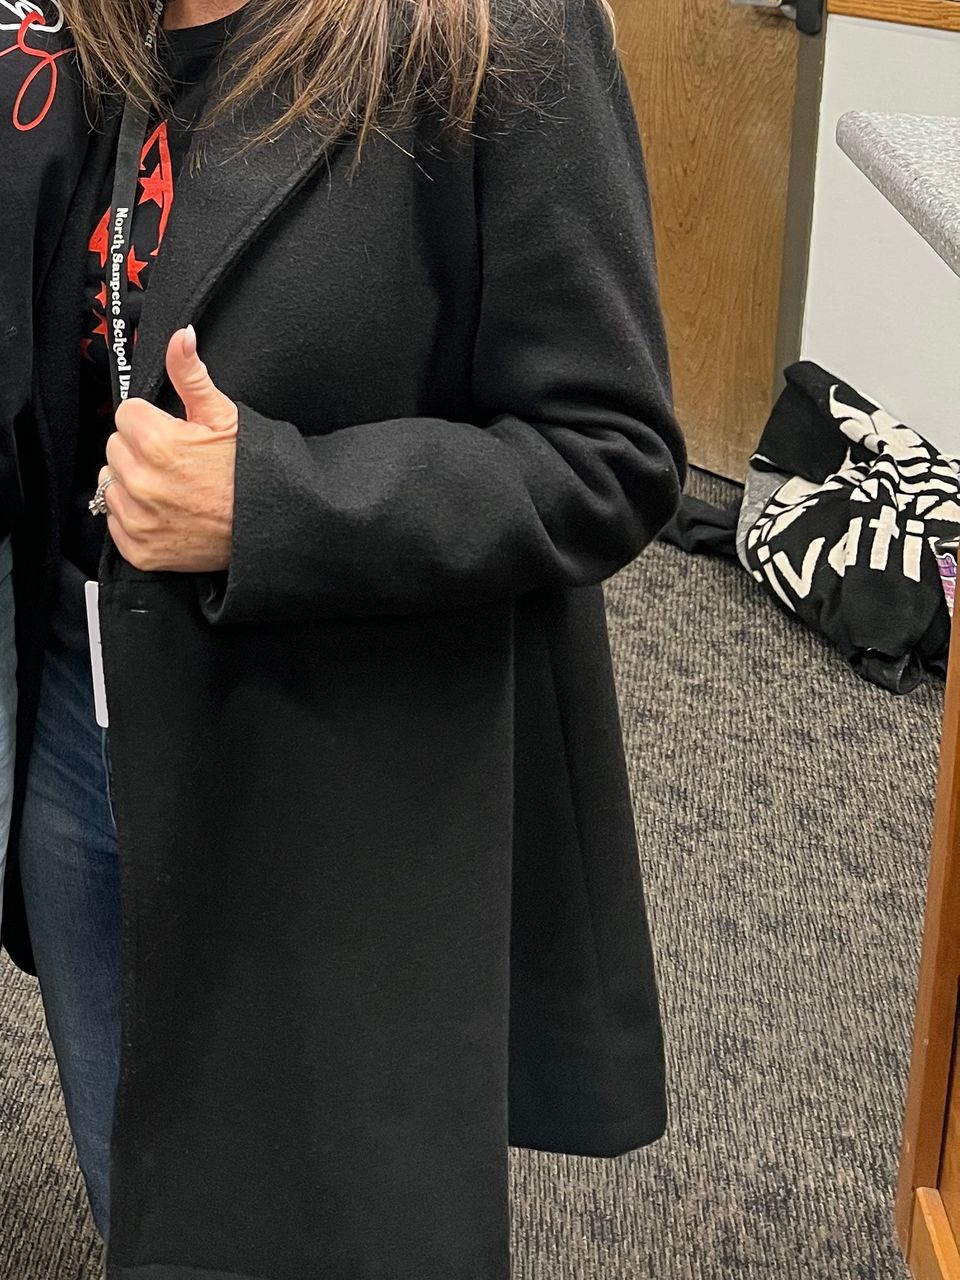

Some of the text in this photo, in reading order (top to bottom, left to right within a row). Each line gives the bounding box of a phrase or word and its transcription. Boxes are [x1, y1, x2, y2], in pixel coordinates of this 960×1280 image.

[110, 206, 129, 253] North
[109, 252, 125, 316] Sanpete
[113, 319, 132, 372] School
